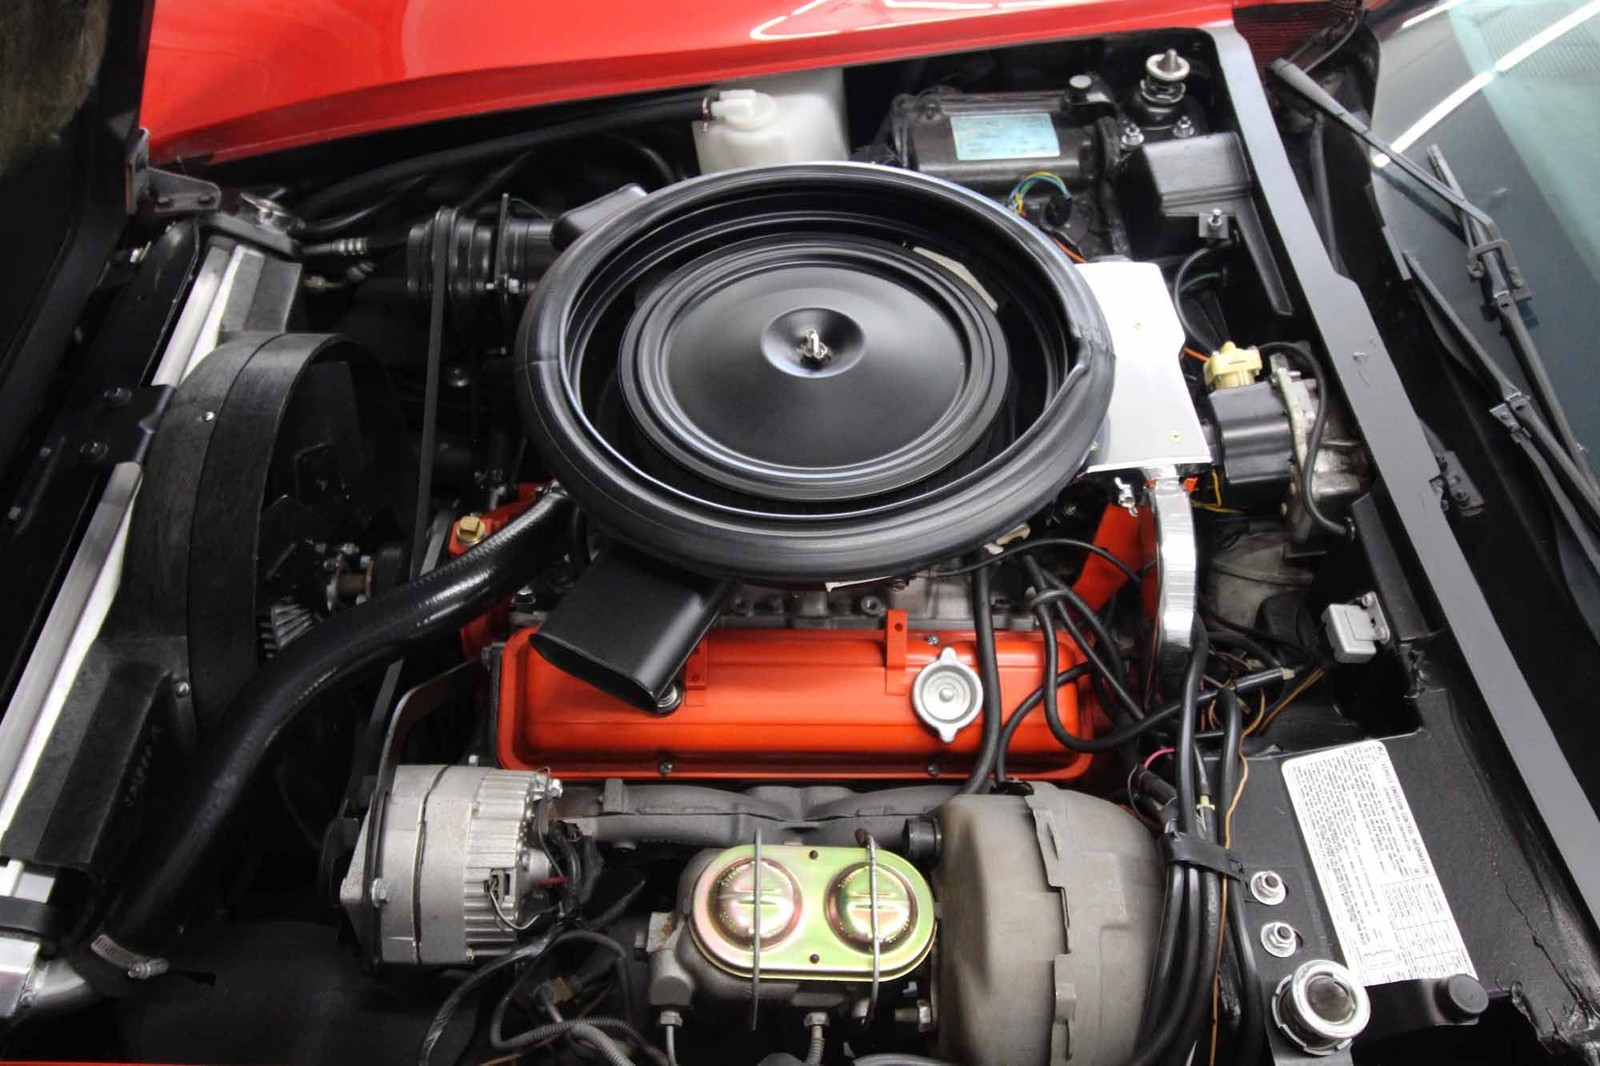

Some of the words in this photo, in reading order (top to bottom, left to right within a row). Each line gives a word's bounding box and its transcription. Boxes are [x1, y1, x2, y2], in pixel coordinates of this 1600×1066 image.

[1382, 762, 1394, 783] VEHICLE
[1391, 785, 1404, 810] EMISSION
[1401, 812, 1414, 834] CONTROL
[1411, 838, 1429, 874] INFORMATION
